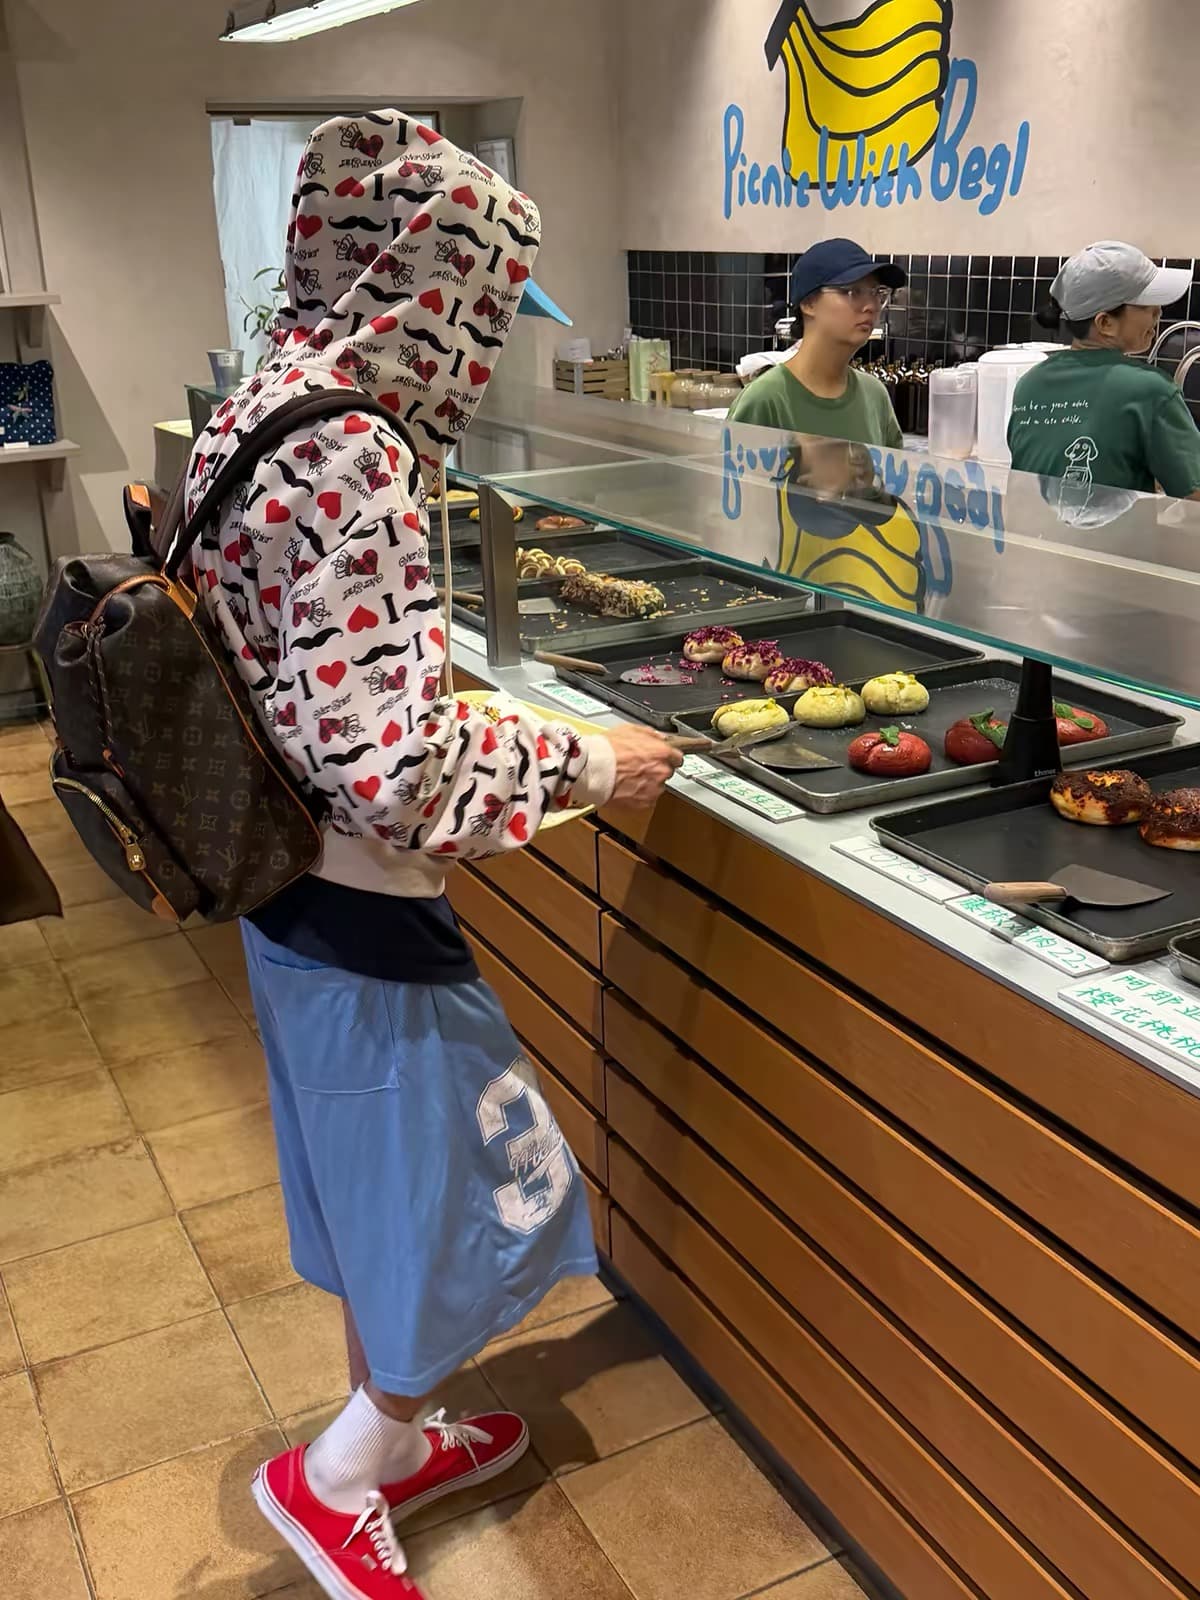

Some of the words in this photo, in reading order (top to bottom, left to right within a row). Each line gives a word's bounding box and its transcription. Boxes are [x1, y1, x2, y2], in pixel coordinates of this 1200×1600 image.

[724, 104, 810, 220] Picnic
[818, 125, 922, 210] With
[929, 57, 1030, 216] Begl
